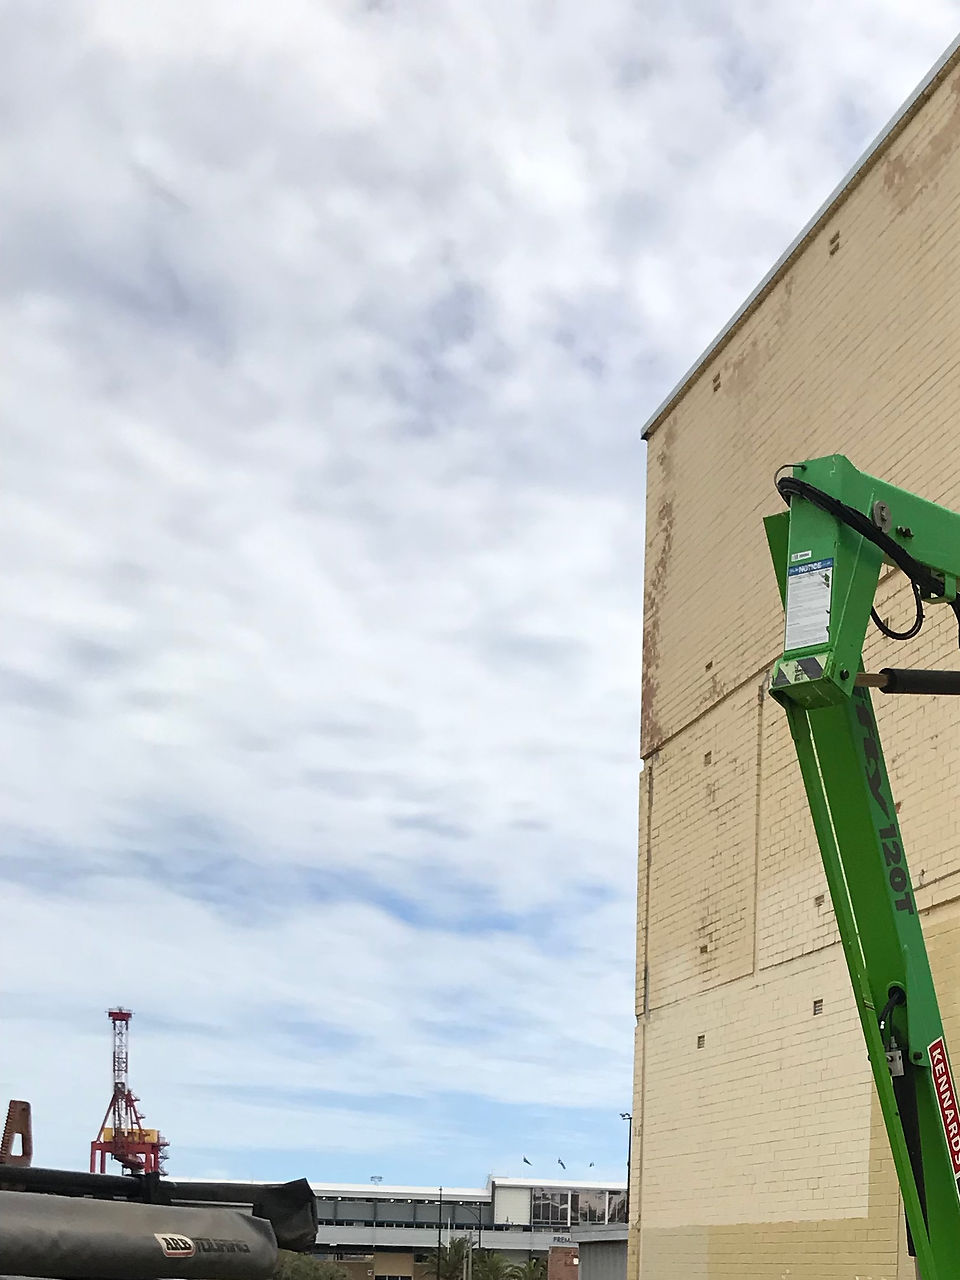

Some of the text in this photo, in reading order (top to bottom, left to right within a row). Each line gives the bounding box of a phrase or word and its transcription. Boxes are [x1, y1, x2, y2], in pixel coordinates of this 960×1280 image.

[798, 561, 822, 573] NOTICE
[878, 823, 915, 915] 120T
[161, 1237, 193, 1251] ARB
